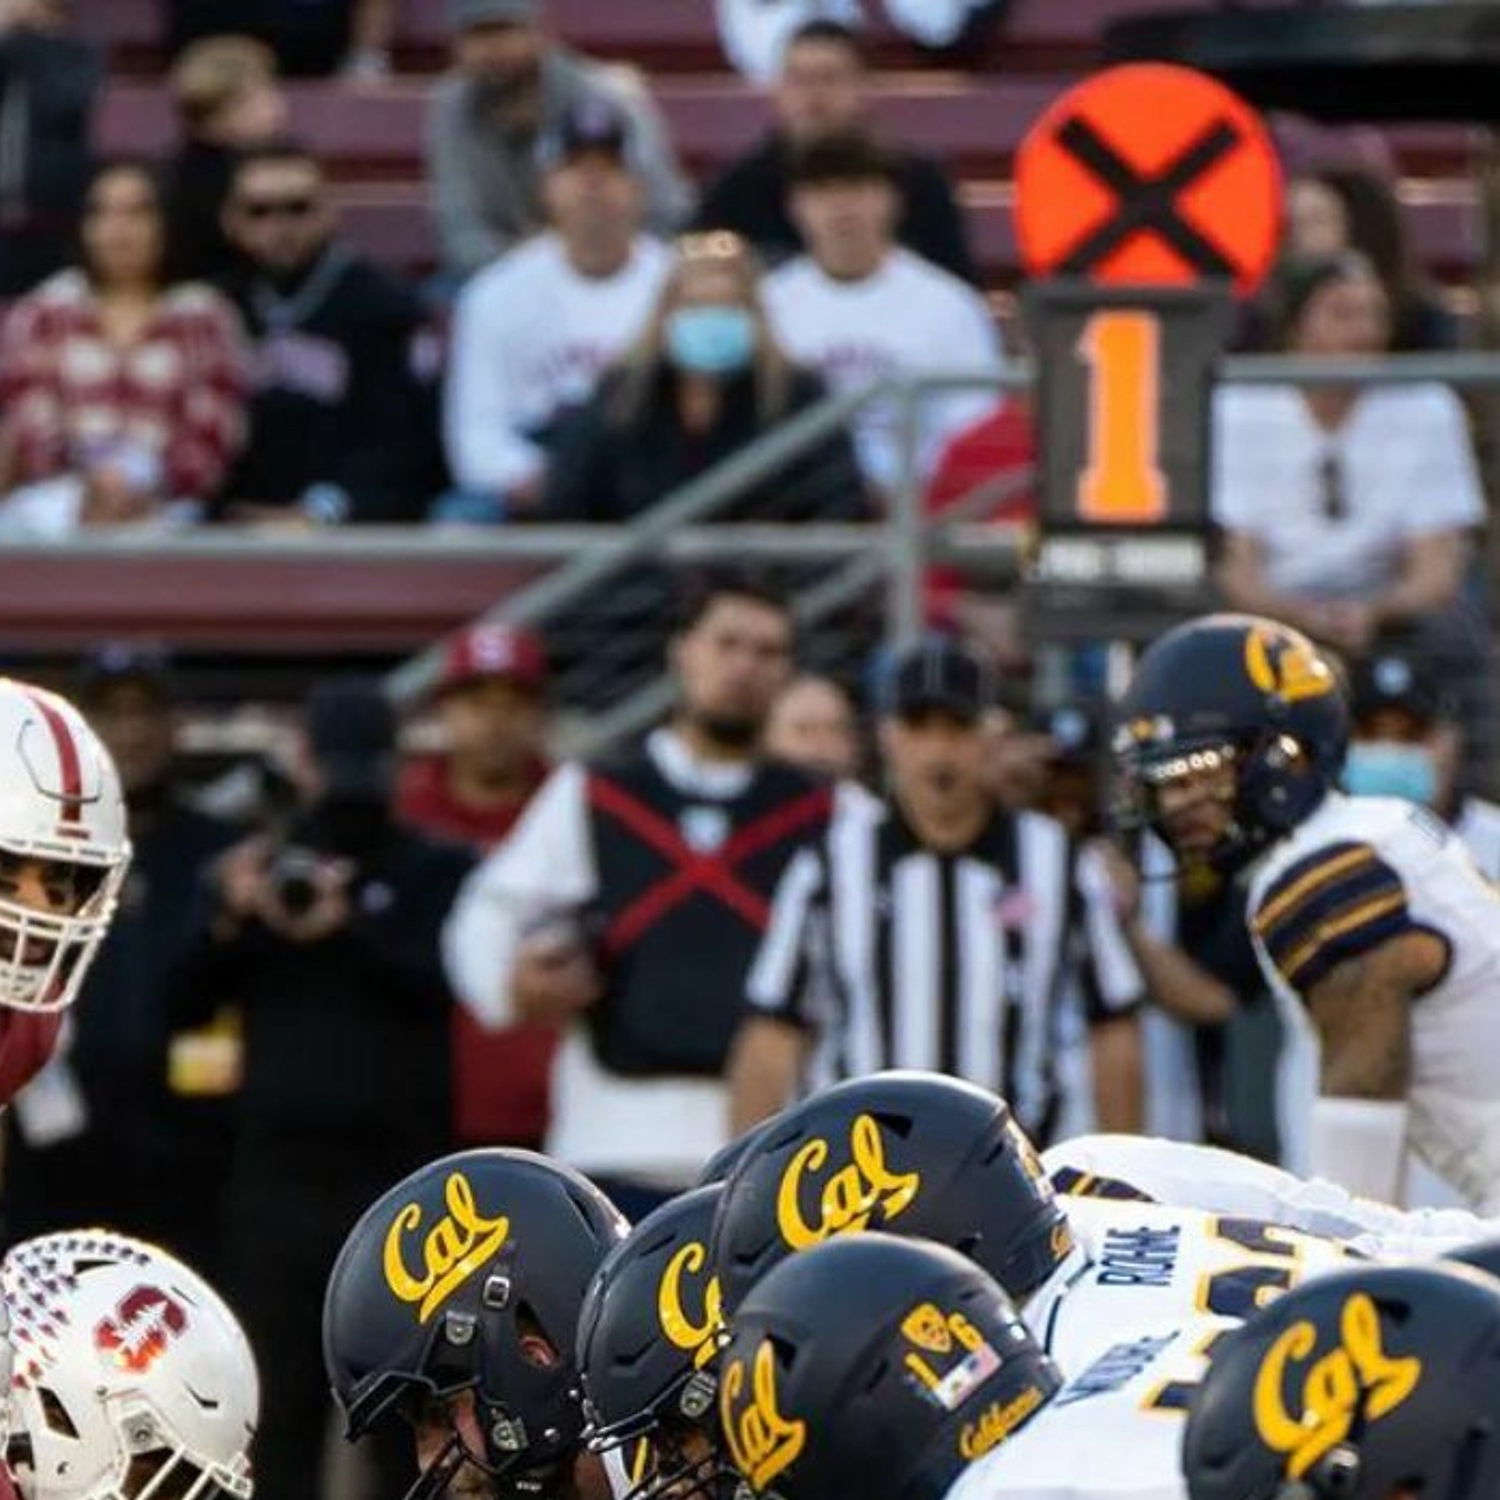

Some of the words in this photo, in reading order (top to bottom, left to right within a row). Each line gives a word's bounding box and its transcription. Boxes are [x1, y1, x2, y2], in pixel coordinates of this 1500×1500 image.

[1075, 311, 1168, 523] 1
[383, 1171, 510, 1324] Cal
[777, 1113, 920, 1252] Cal
[92, 1284, 188, 1374] S
[1254, 1292, 1422, 1480] Cal
[721, 1339, 806, 1491] Cal
